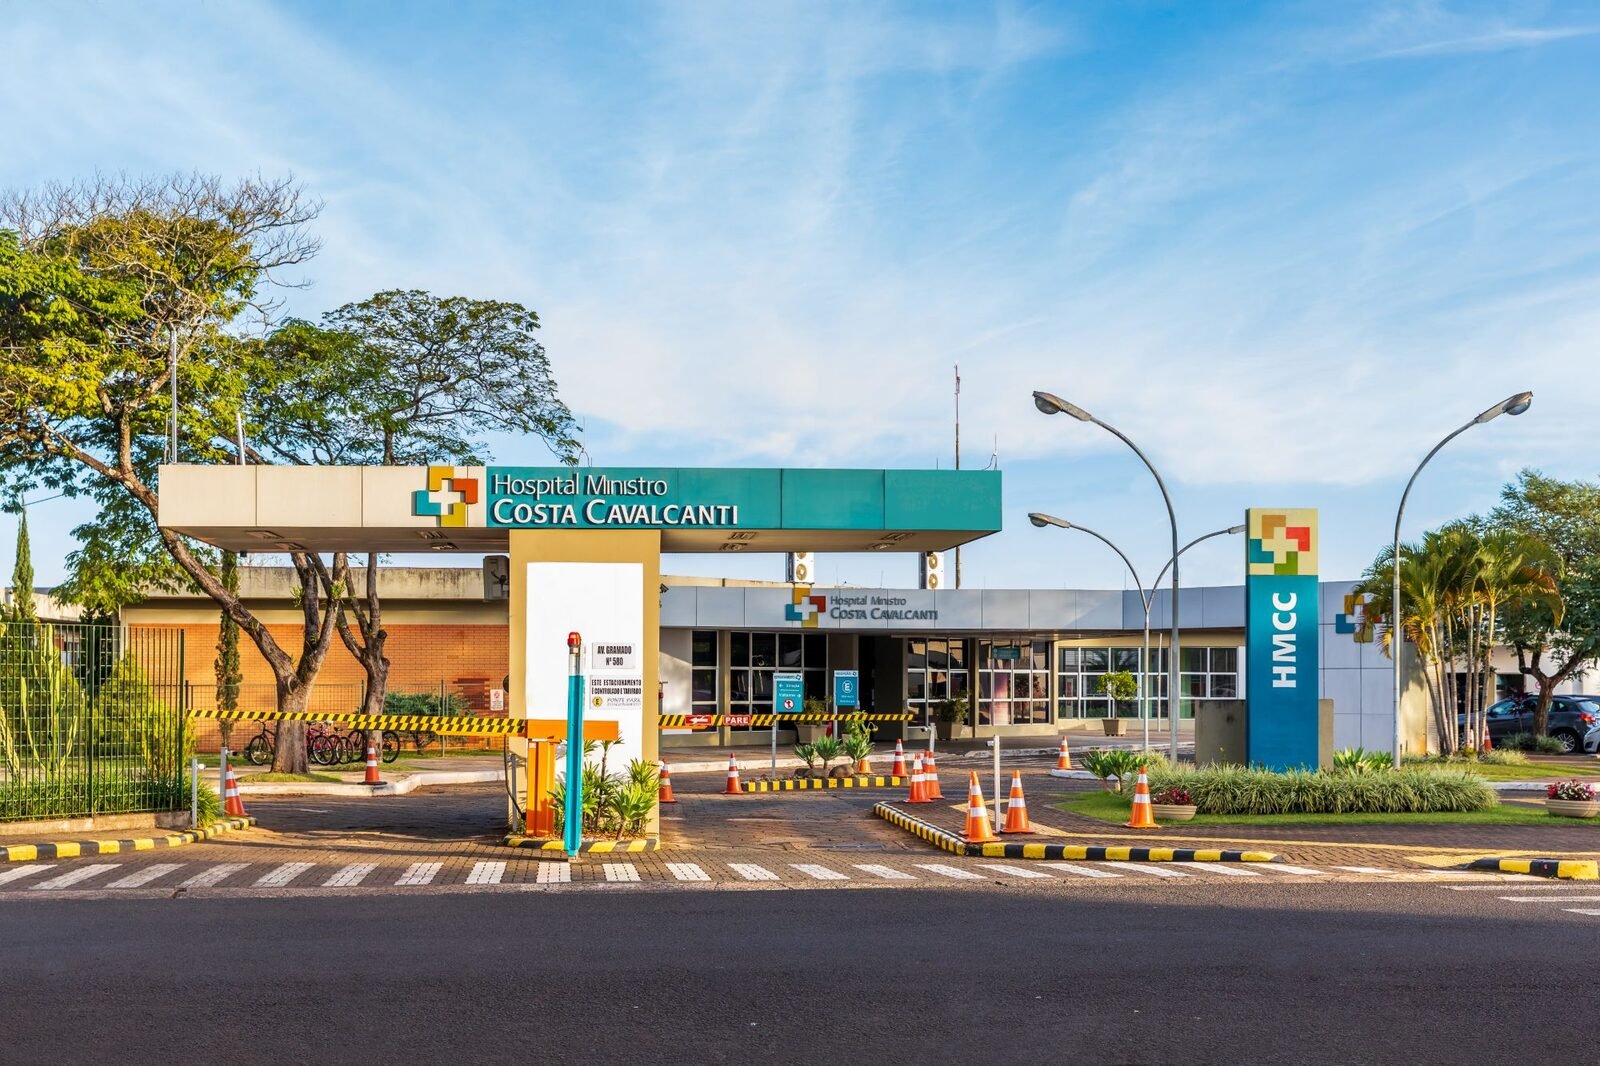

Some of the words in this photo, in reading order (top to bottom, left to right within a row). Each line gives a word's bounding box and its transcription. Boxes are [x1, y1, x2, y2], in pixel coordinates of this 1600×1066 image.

[494, 472, 580, 500] Hospital
[586, 474, 668, 496] Ministro
[493, 498, 577, 525] COSTA
[586, 498, 738, 525] CAVALCANTI
[830, 595, 867, 607] Hospital
[870, 596, 906, 606] Ministro
[830, 607, 867, 620] COSTA
[870, 607, 938, 620] CAVALCANTI
[1272, 592, 1297, 688] HMCC
[606, 646, 632, 654] GRAMADO
[612, 657, 624, 666] 580
[725, 716, 748, 724] PARE
